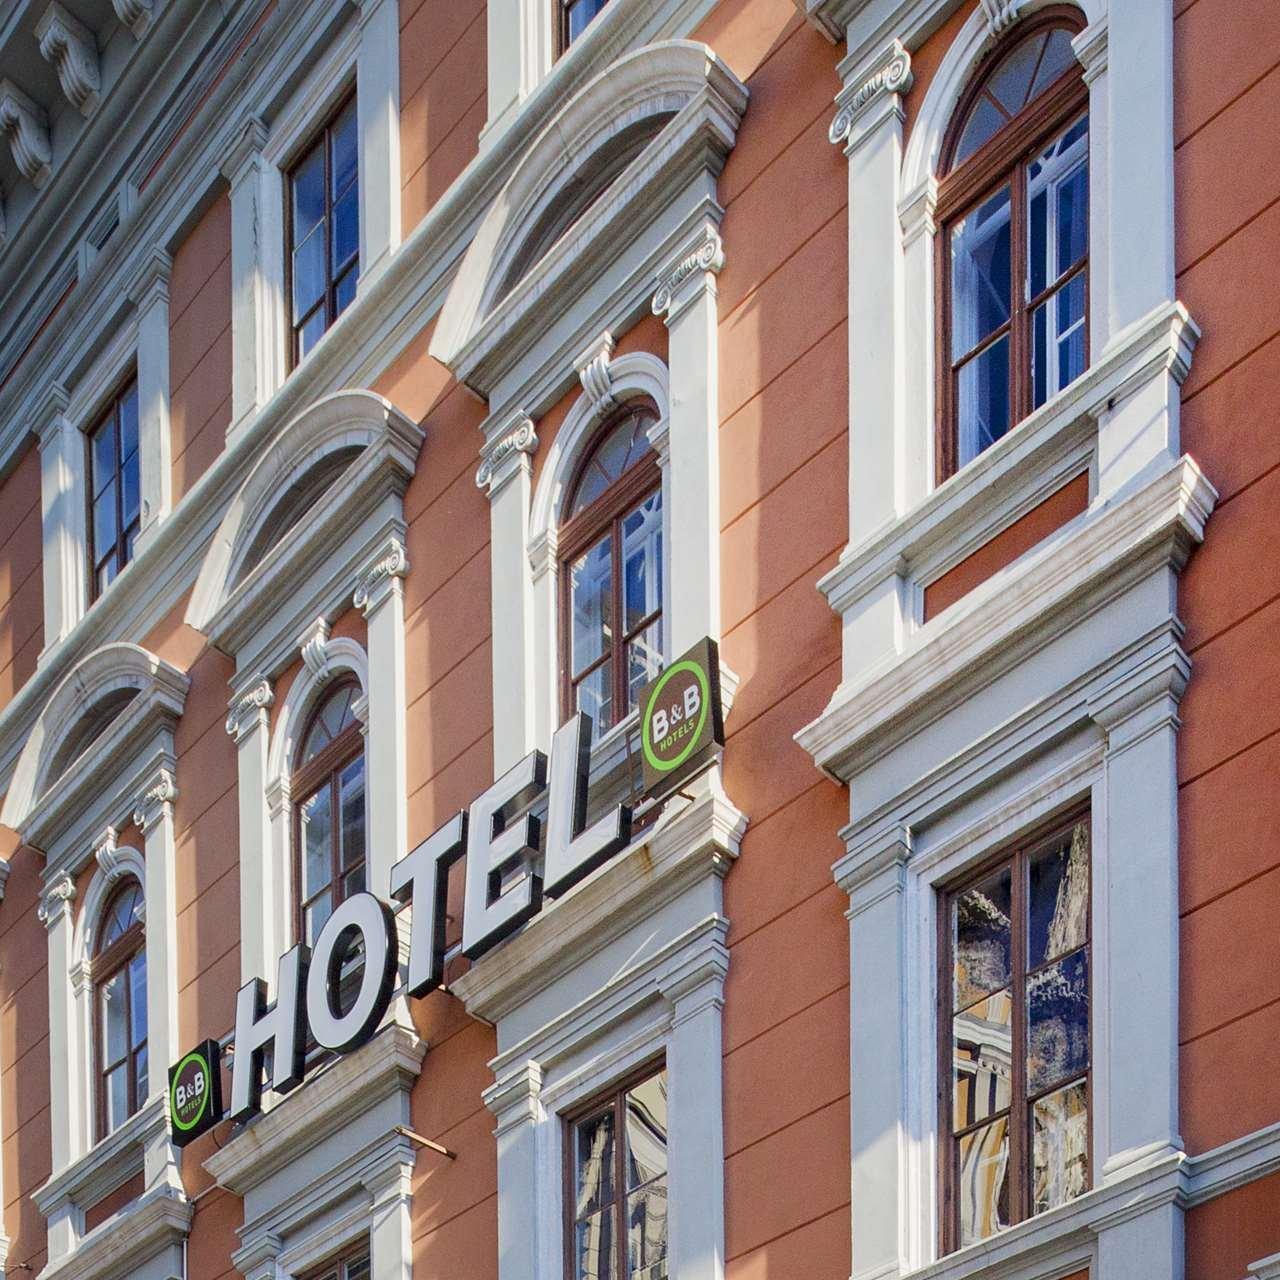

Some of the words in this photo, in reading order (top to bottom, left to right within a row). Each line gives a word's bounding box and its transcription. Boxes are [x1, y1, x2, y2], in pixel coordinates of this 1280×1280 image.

[652, 684, 700, 744] B&B
[660, 720, 695, 752] HOTELS
[230, 711, 631, 1123] HOTEL
[176, 1071, 205, 1109] B&B
